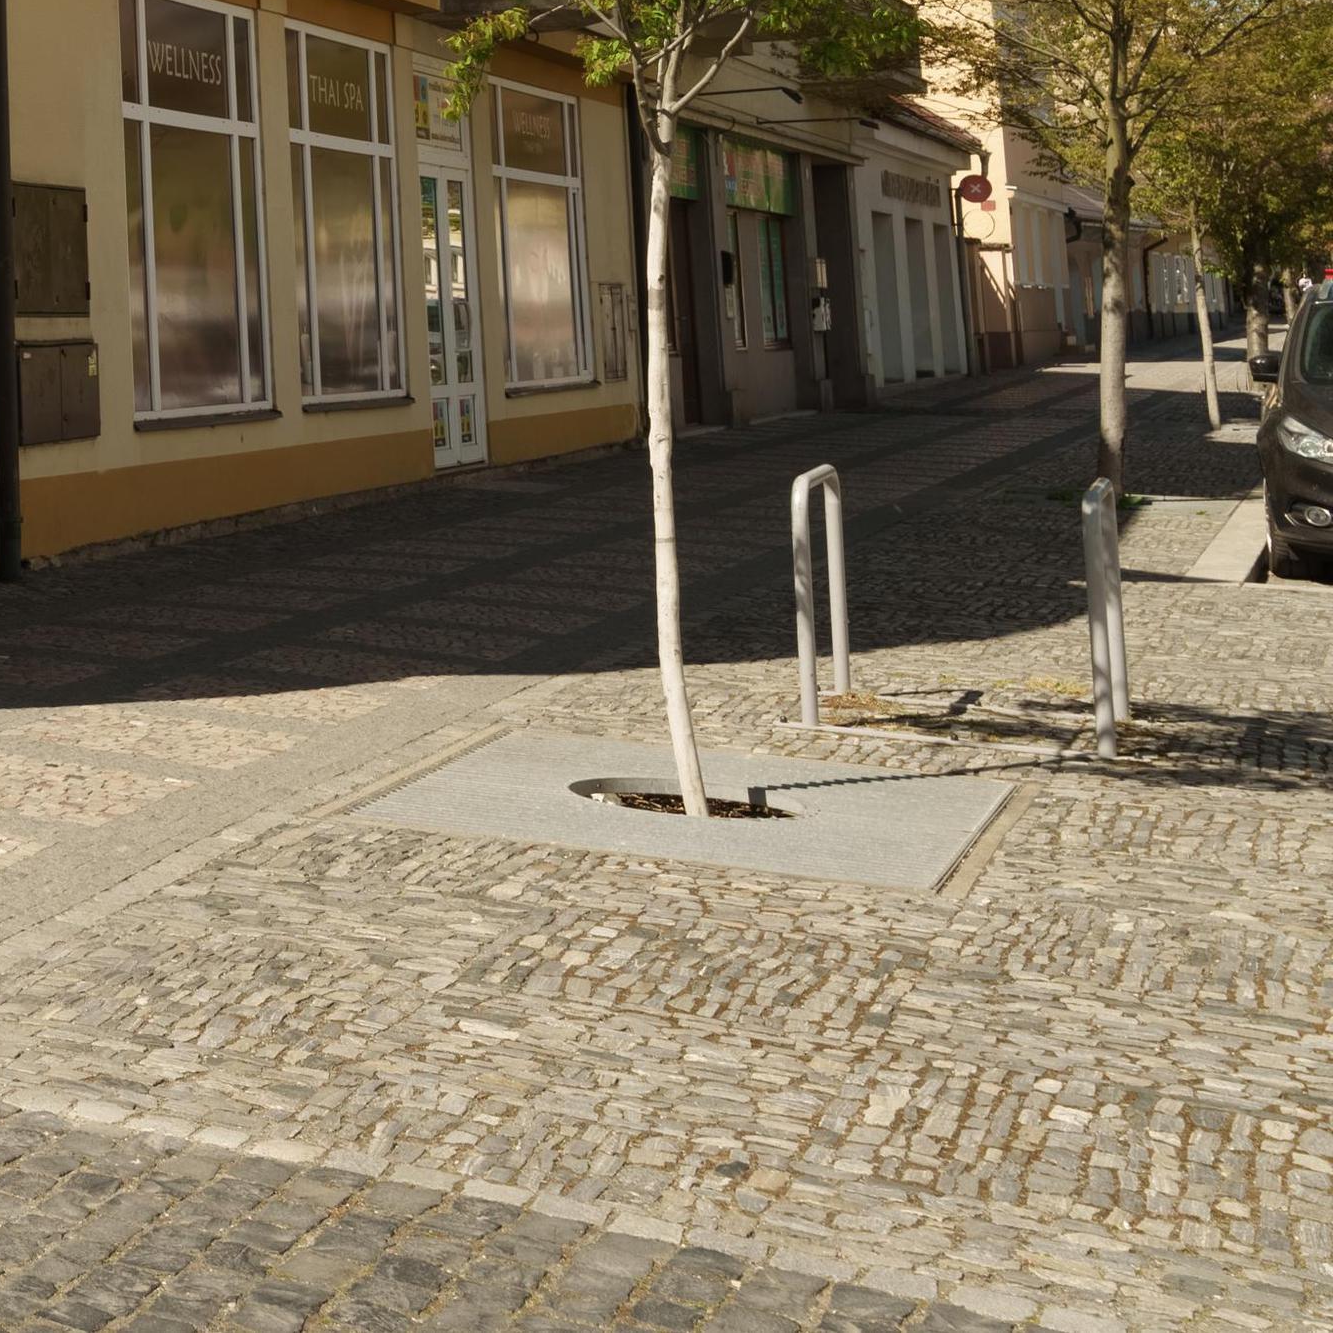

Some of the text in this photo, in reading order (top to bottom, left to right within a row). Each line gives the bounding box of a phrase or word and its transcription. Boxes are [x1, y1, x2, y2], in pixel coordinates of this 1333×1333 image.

[147, 39, 222, 86] WELLNESS
[309, 74, 364, 112] THAI SPA
